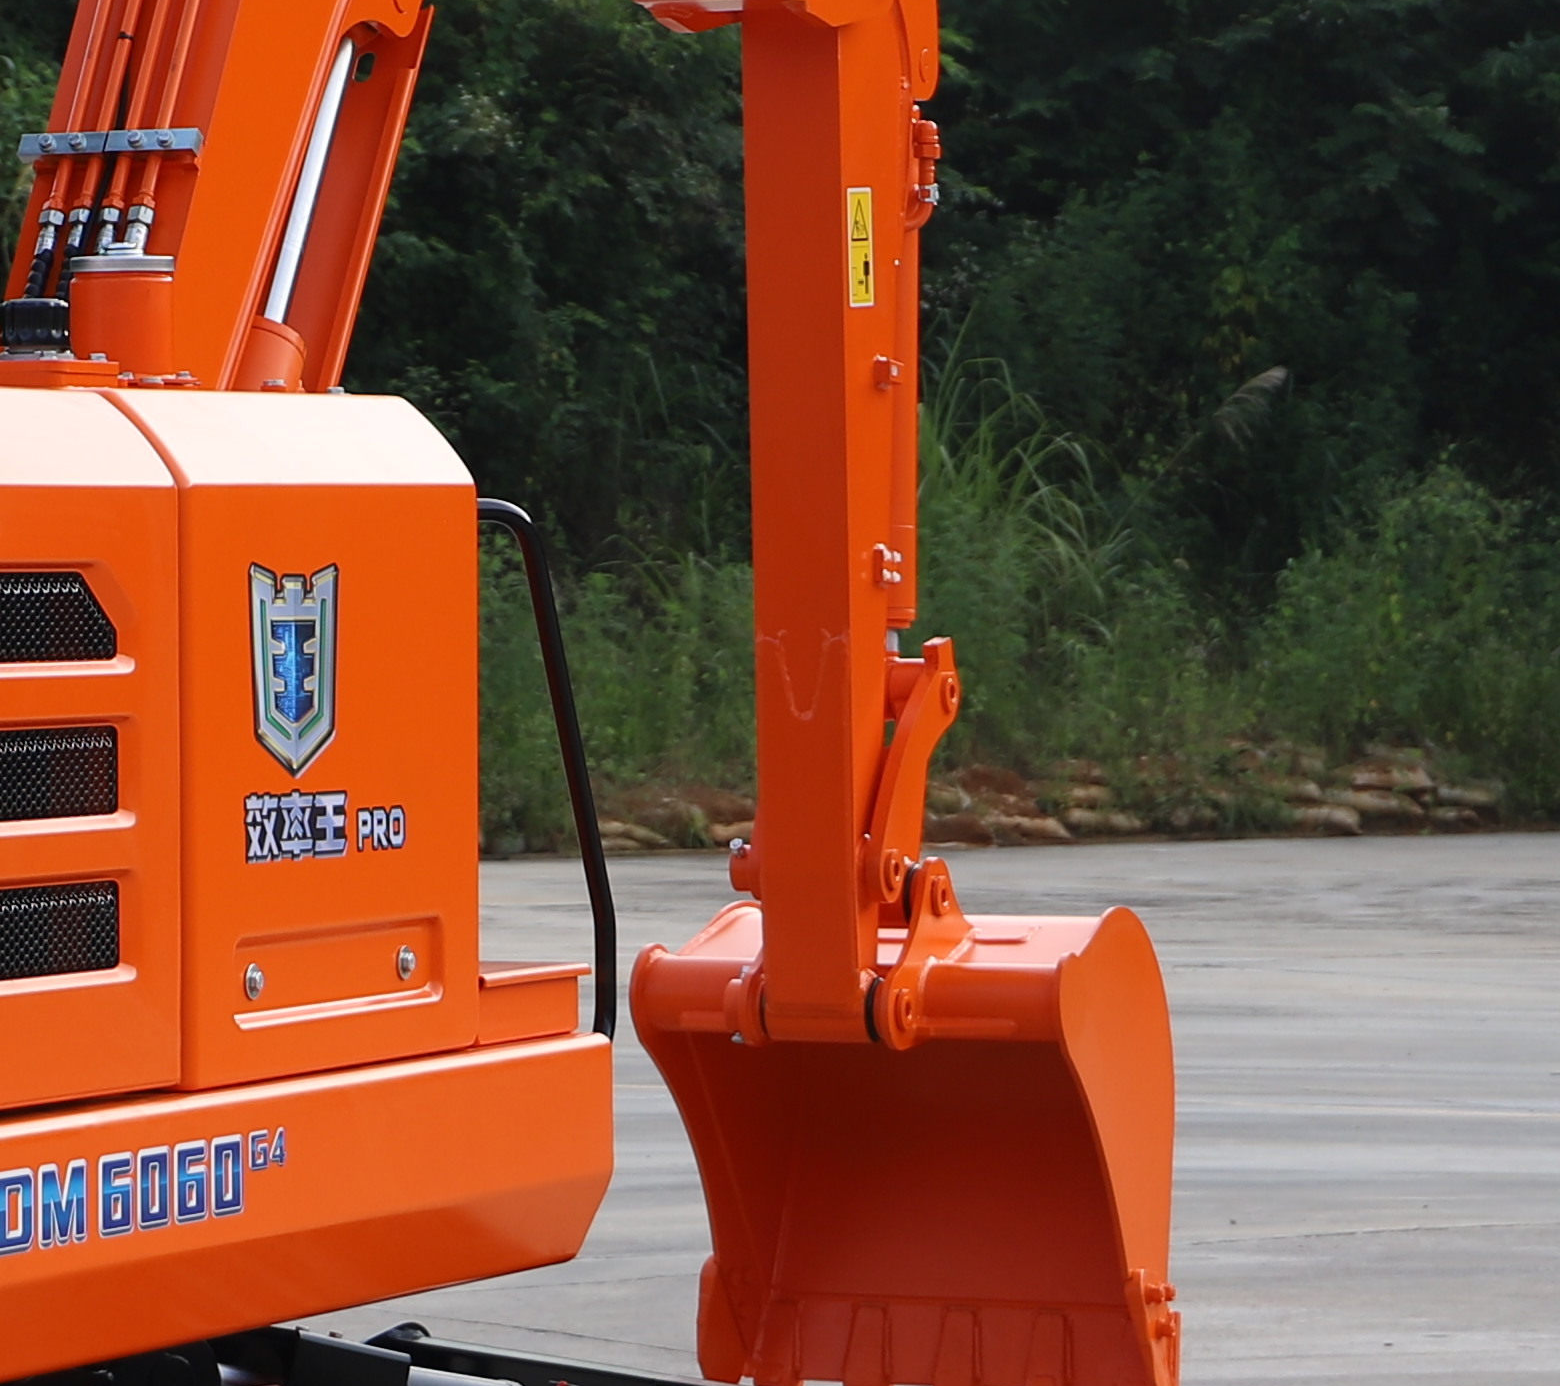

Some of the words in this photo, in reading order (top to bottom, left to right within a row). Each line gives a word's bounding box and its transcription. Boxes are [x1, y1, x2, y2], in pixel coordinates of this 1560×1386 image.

[244, 788, 348, 864] 效率王
[356, 804, 407, 853] PRO
